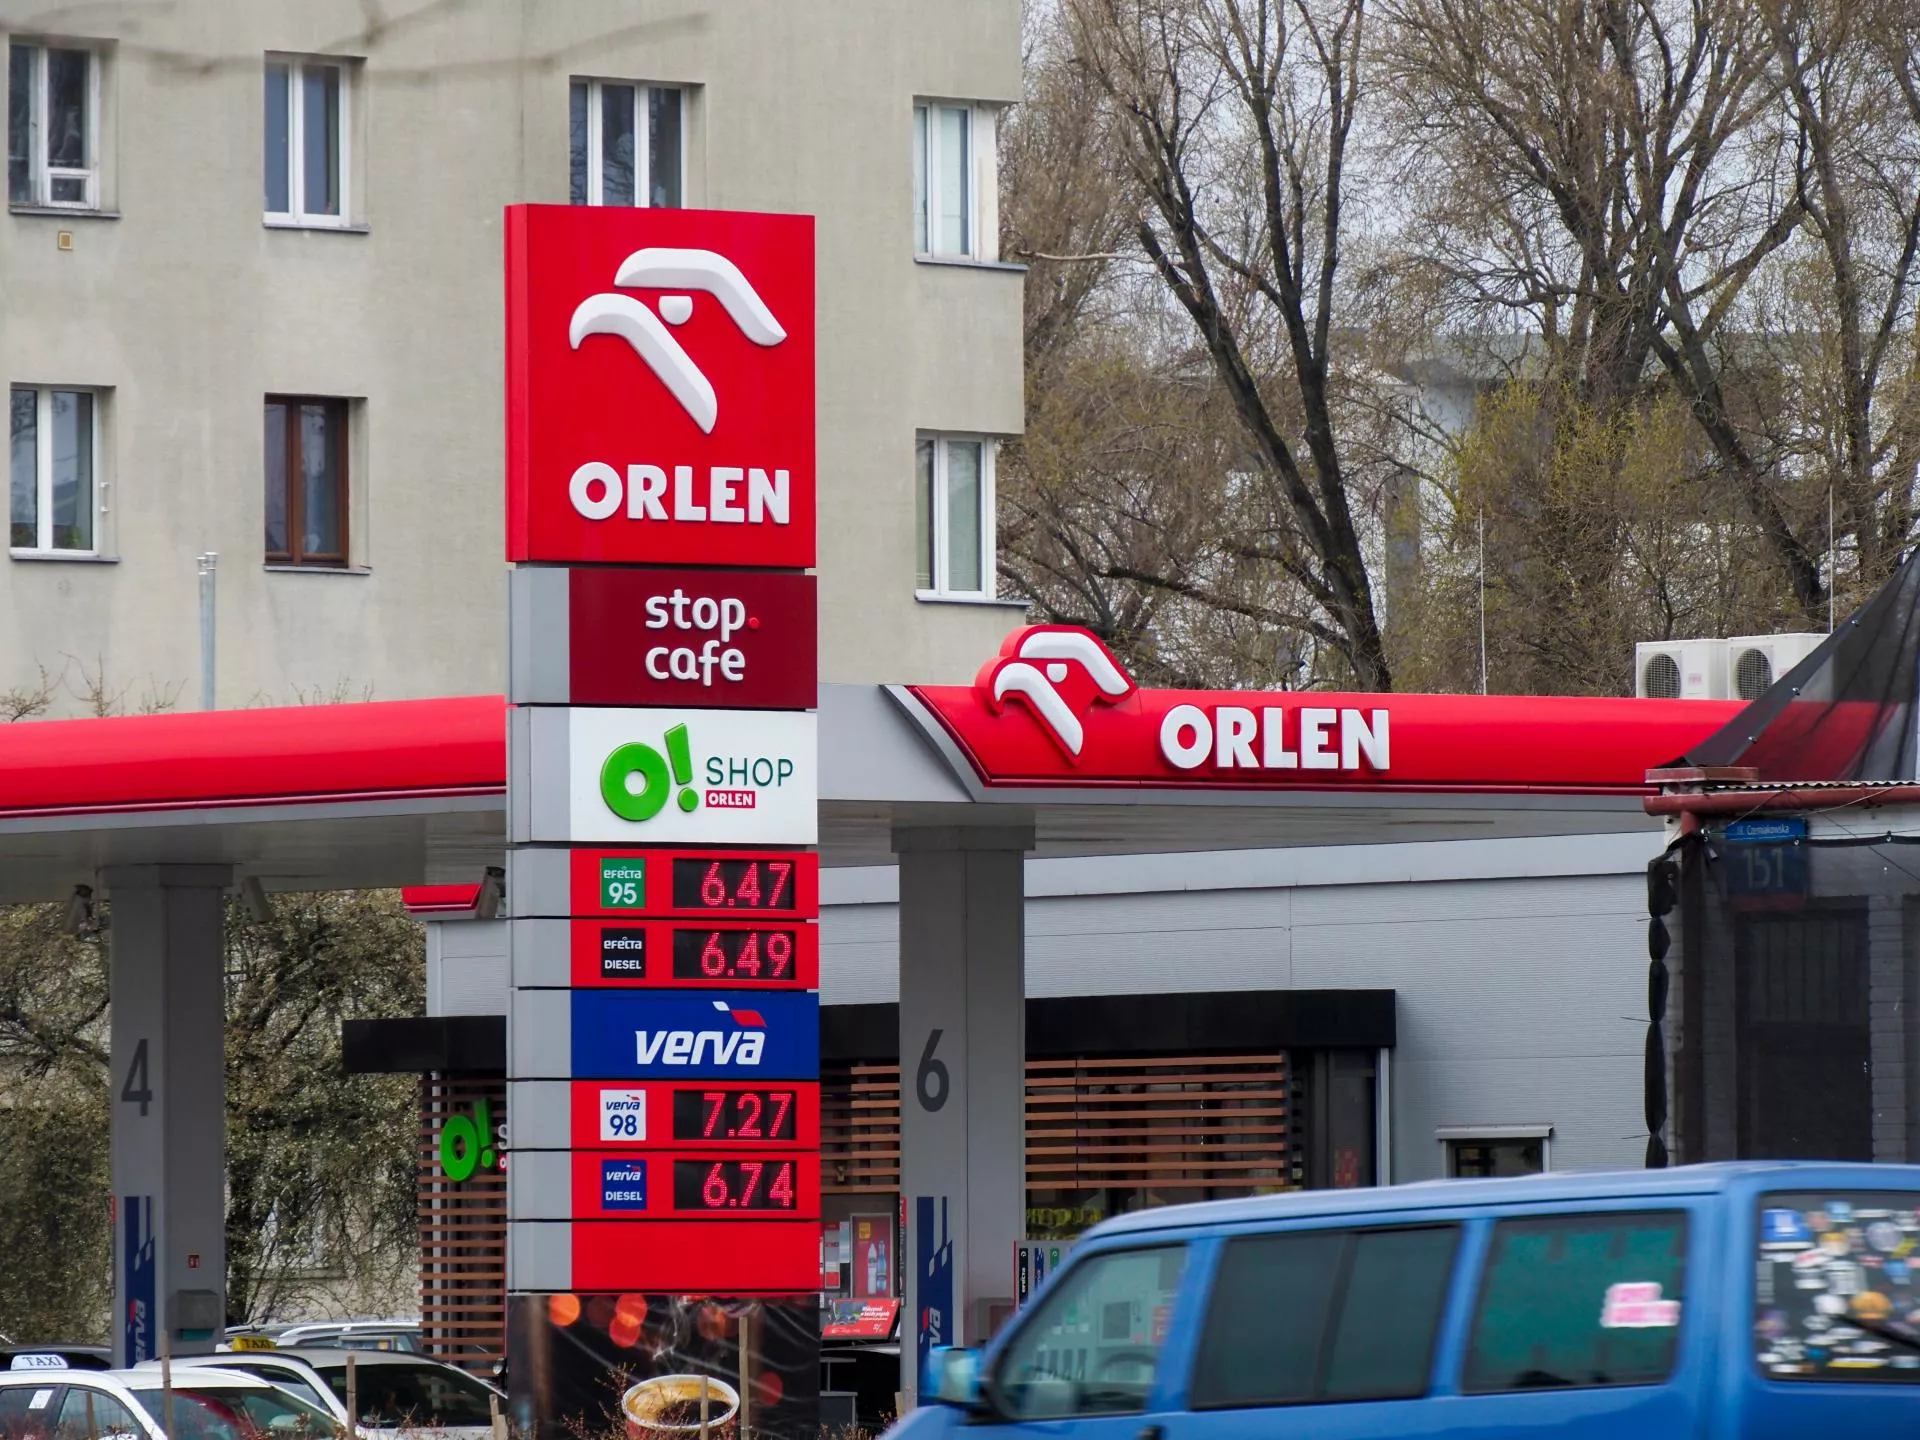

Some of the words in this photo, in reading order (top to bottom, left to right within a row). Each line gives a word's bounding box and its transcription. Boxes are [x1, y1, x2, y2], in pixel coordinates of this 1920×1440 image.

[569, 461, 790, 525] ORLEN
[645, 640, 746, 687] cafe
[1159, 704, 1391, 771] ORLEN
[600, 722, 699, 822] O!
[706, 756, 794, 787] SHOP
[708, 792, 753, 806] ORLEN
[701, 862, 792, 907] 6.47
[1743, 848, 1784, 889] 151
[608, 882, 638, 905] 95
[604, 959, 642, 970] DIESEL
[701, 932, 792, 977] 6.49
[635, 1030, 766, 1065] verva
[916, 1028, 949, 1112] 6
[121, 1039, 153, 1116] 4
[606, 1100, 641, 1111] verva
[609, 1114, 638, 1136] 98
[703, 1092, 793, 1138] 7.27
[441, 1098, 494, 1182] O!
[605, 1191, 643, 1201] DIESEL
[606, 1170, 641, 1181] verva
[703, 1162, 794, 1207] 6.74
[22, 1356, 62, 1367] TAXI
